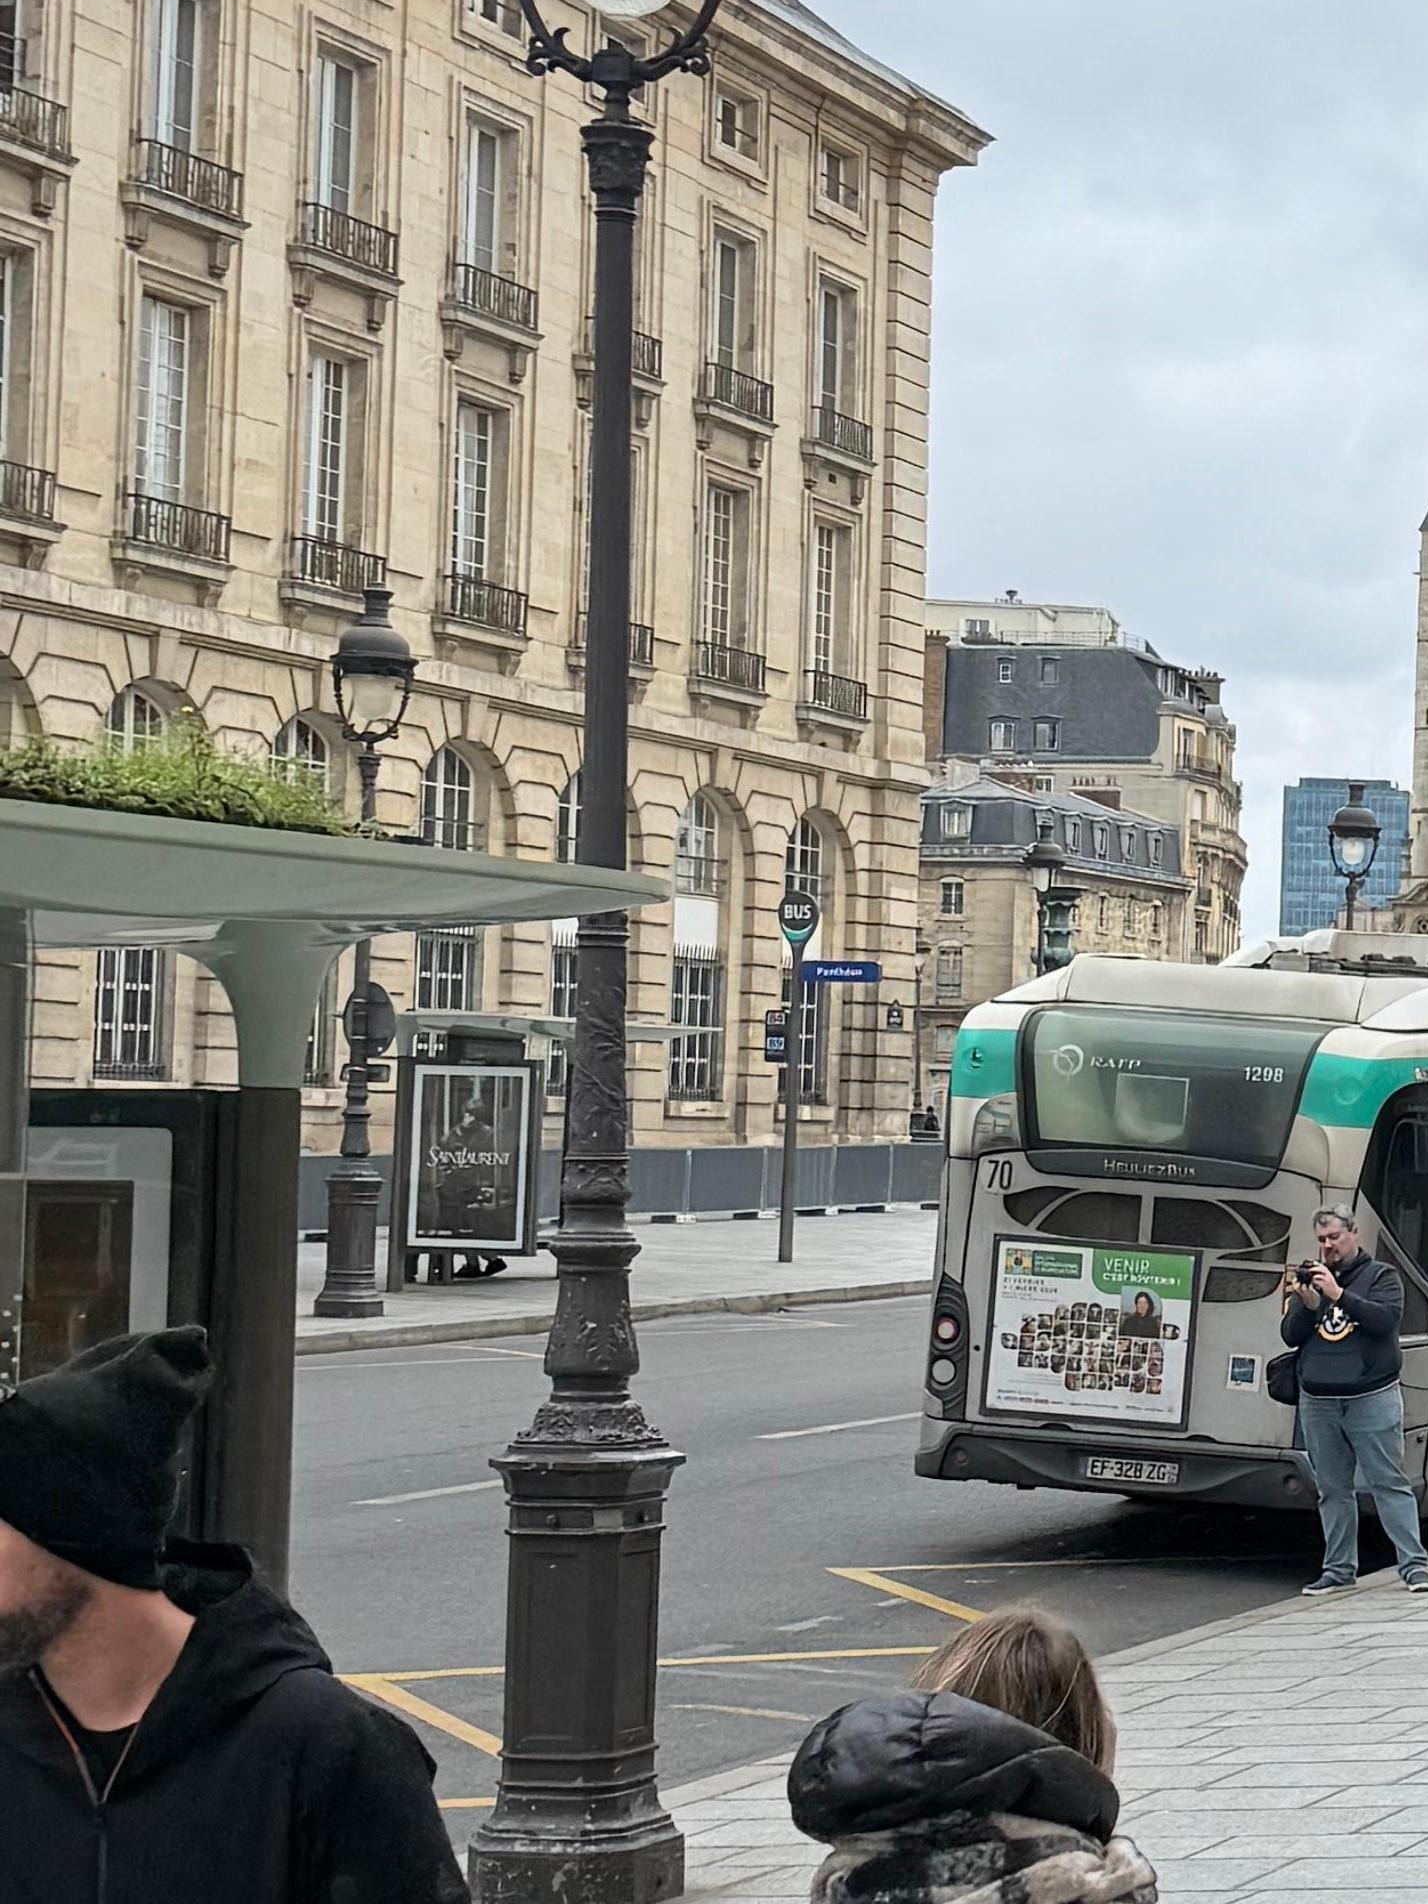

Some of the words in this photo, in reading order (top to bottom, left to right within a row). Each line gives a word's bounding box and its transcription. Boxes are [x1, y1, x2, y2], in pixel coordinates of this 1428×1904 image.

[783, 904, 812, 920] BUS
[1090, 1056, 1141, 1070] RATP
[987, 1160, 1013, 1190] 70
[1104, 1257, 1150, 1274] VENIR
